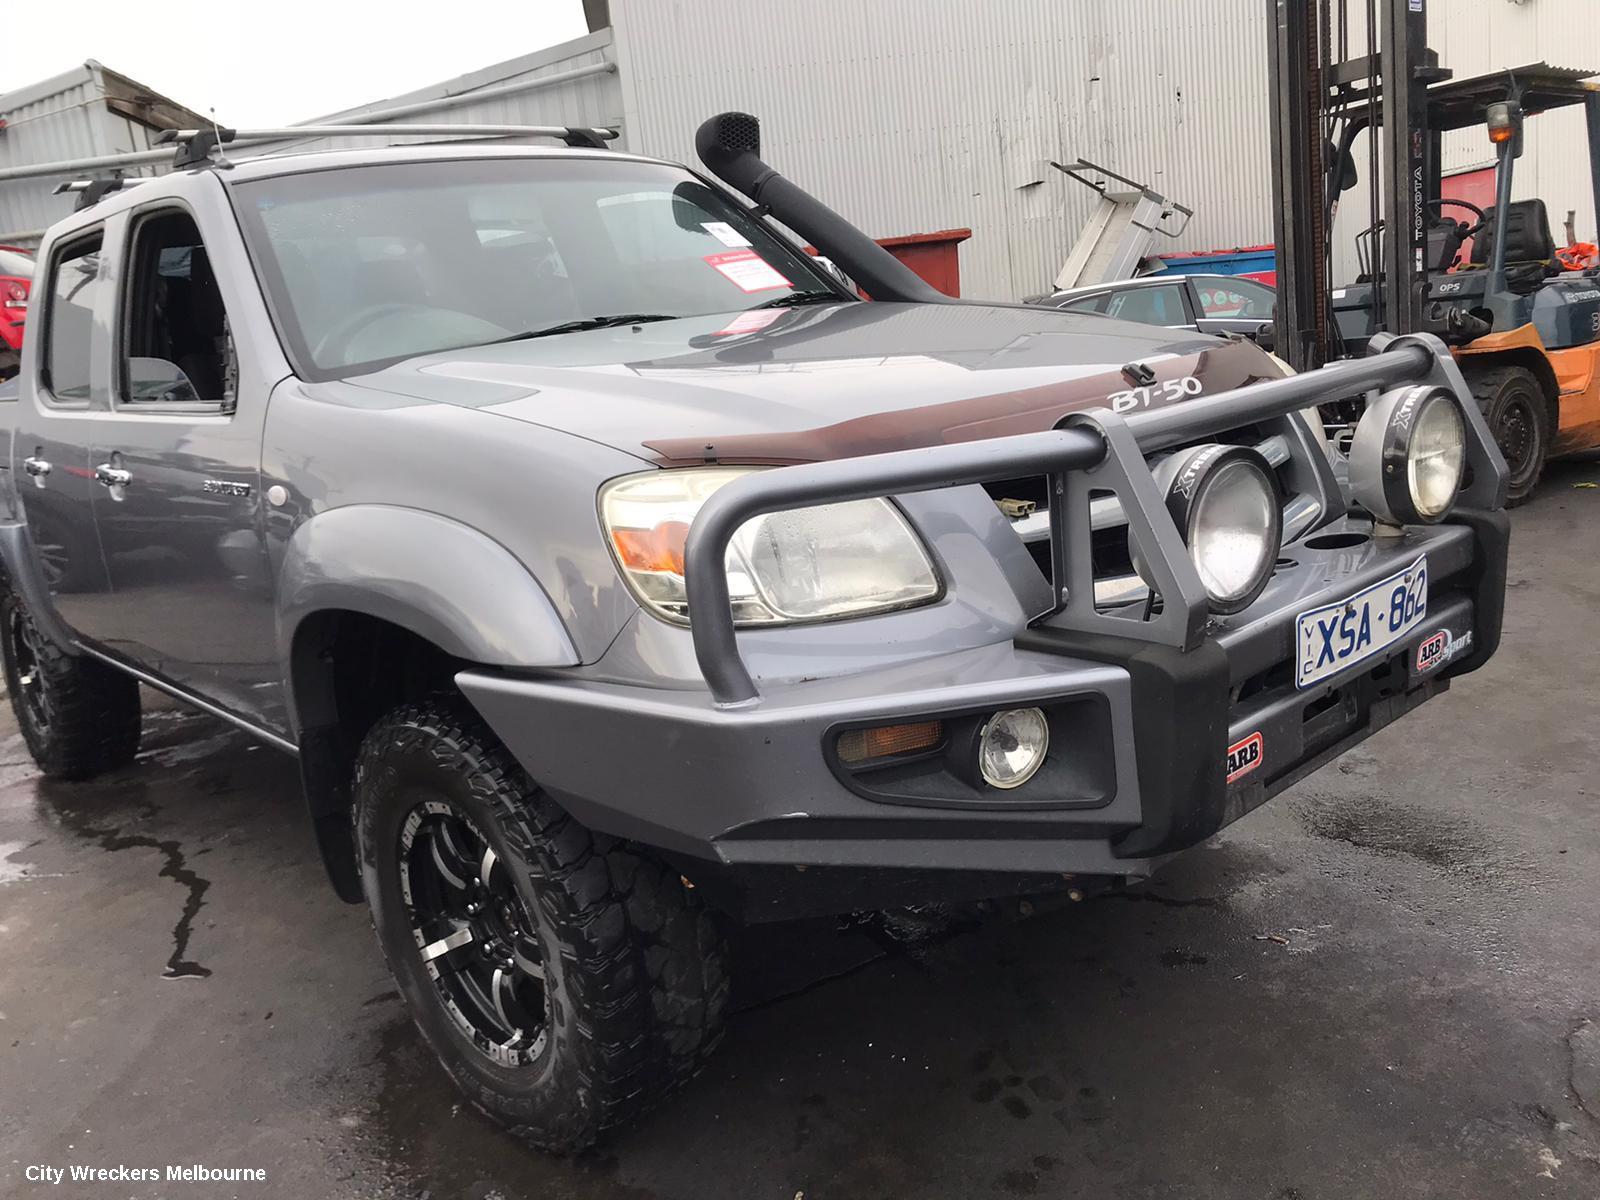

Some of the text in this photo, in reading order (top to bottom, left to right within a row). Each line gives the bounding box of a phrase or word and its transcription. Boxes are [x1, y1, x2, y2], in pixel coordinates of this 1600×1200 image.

[1414, 166, 1423, 241] TOYOTA
[1439, 282, 1461, 292] OPS
[1106, 376, 1203, 414] BT-50
[1420, 638, 1442, 664] ARB
[1226, 741, 1259, 775] ARB
